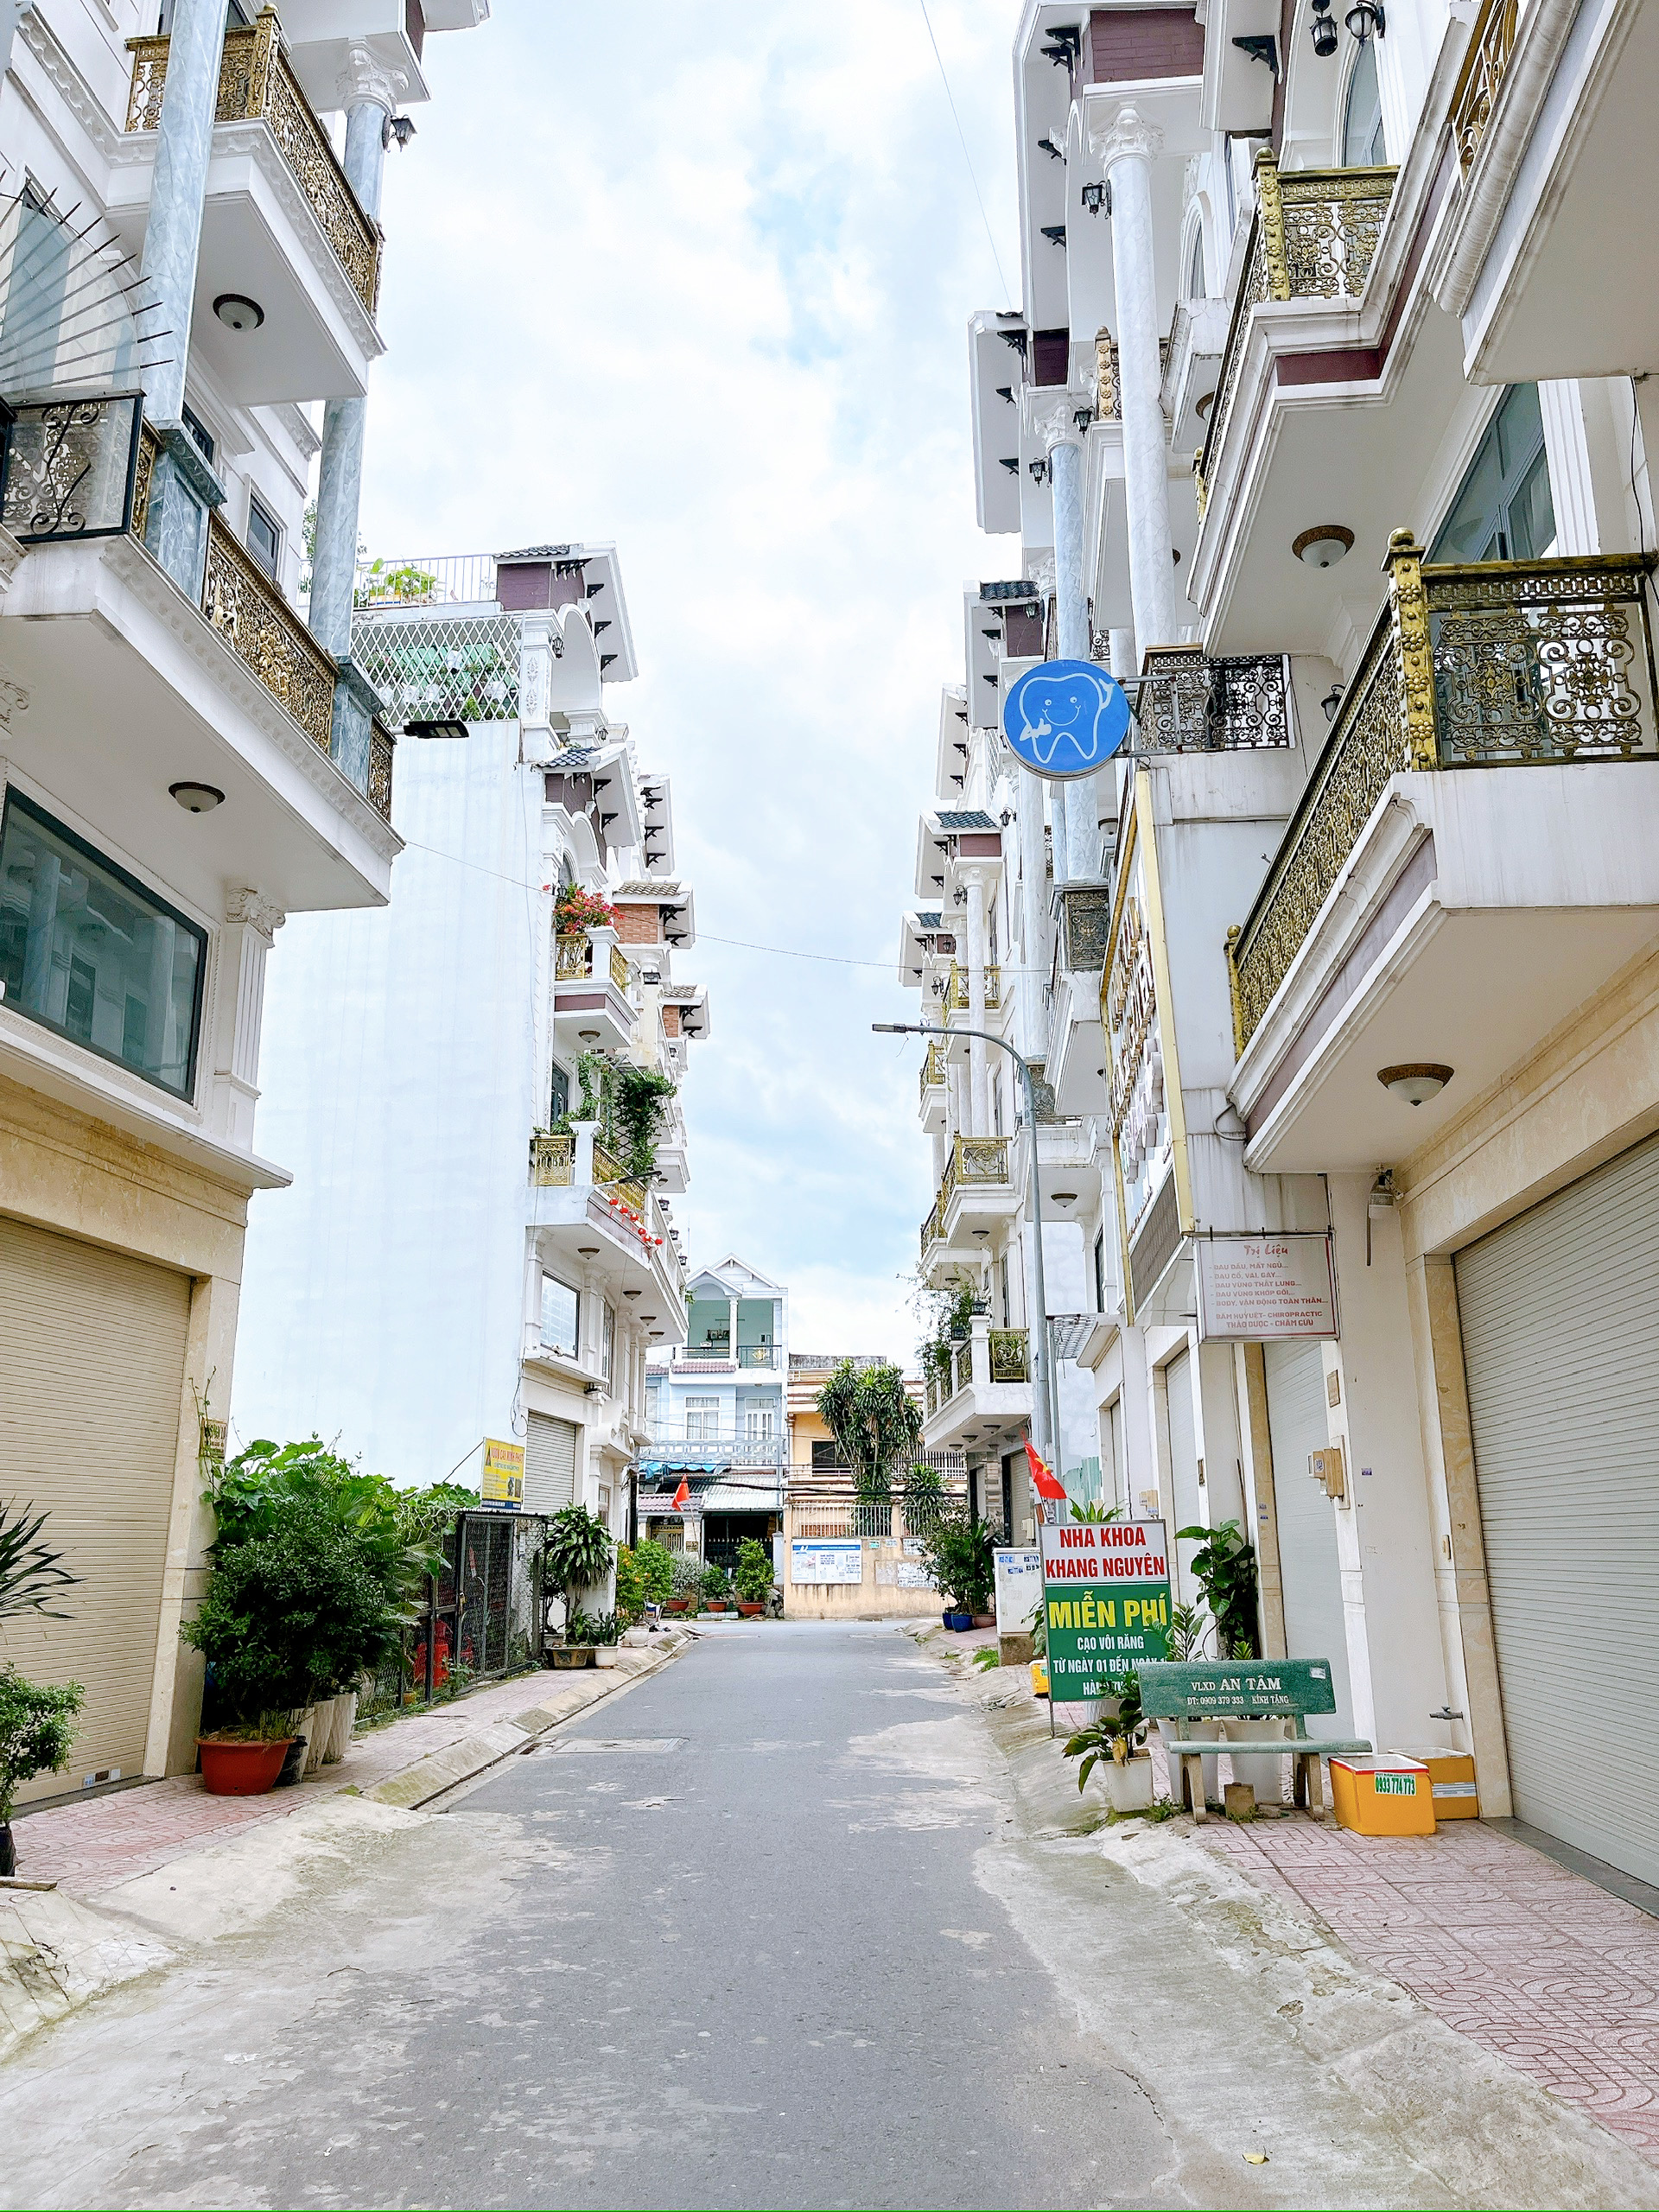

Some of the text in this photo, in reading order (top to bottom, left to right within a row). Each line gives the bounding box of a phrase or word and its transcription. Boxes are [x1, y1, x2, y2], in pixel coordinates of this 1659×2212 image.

[1264, 1243, 1288, 1257] Liệu
[1059, 1527, 1146, 1548] NHA KHOA
[1046, 1552, 1165, 1578] KHANG NGUYÊN
[1049, 1591, 1167, 1629] MIỄN PHÍ
[1077, 1633, 1145, 1653] CẠO VÔI RĂNG
[1052, 1656, 1066, 1674] TỪ
[1067, 1656, 1094, 1673] NGÀY
[1096, 1659, 1108, 1672] 01
[1109, 1654, 1129, 1673] ĐẾN
[1191, 1675, 1282, 1692] VLXD AN TÂM
